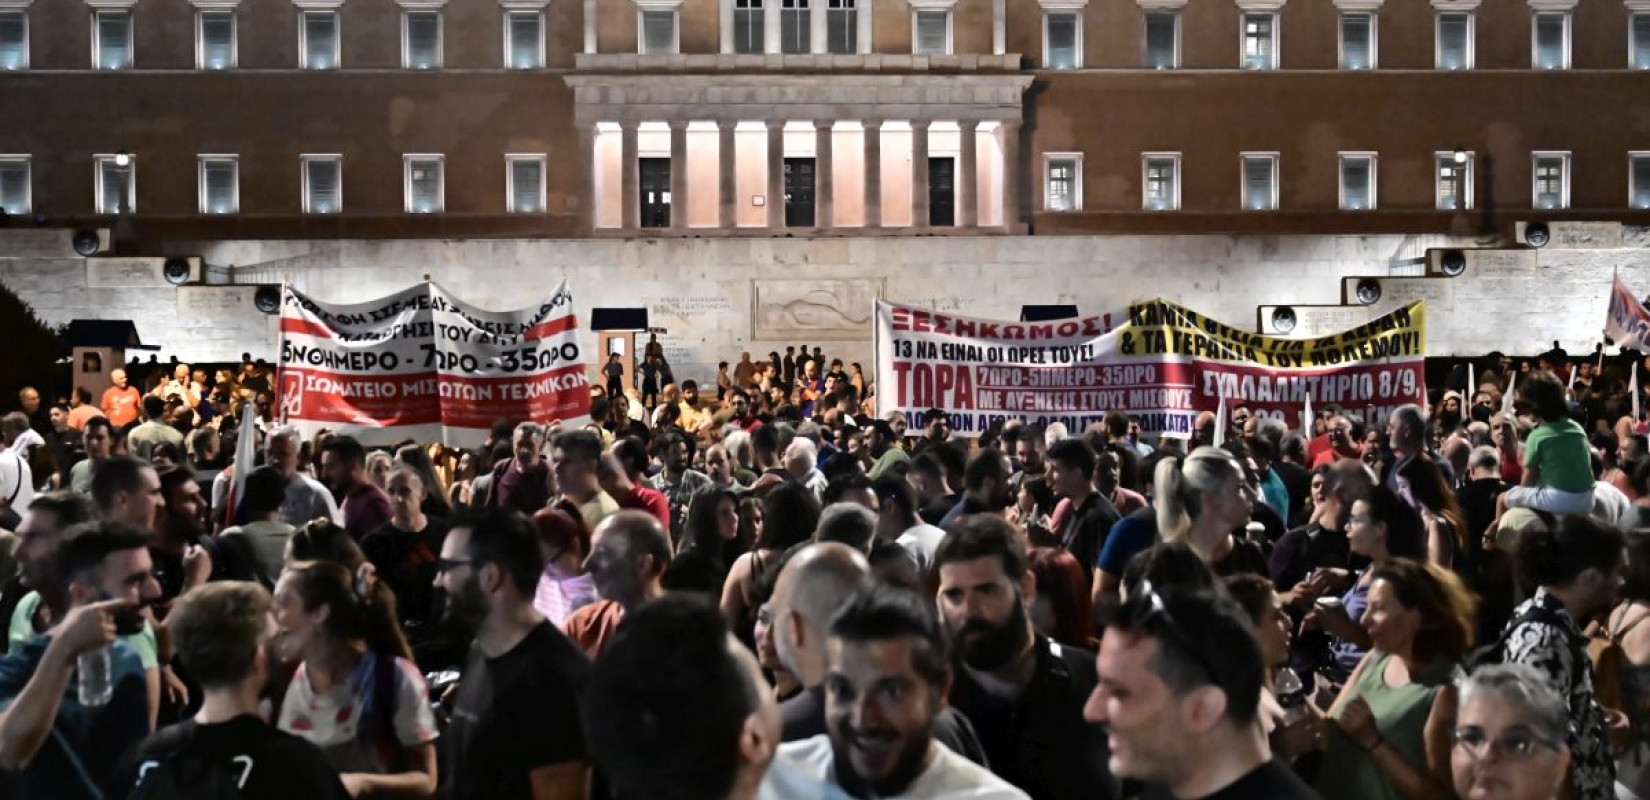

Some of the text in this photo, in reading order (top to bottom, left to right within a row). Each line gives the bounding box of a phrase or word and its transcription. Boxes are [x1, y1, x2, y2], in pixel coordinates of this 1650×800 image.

[891, 307, 1112, 340] ΞΕΣΗΚΩΜΟΣ!
[1129, 303, 1198, 330] ΚΑΜΙΑ
[439, 323, 474, 343] ΤΟΥ
[281, 340, 399, 371] 5ΝΘΗΜΕΡΟ
[419, 343, 478, 373] 7ΩΡΟ
[501, 342, 579, 373] 35ΩΡΟ
[893, 340, 1094, 364] 13 ΝΑ ΕΙΝΑΙ ΟΙ ΩΡΕΣ ΤΟΥΣ!
[1121, 330, 1420, 368] & ΤΑ ΓΕΡΑΚΙΑ ΤΟΥ ΠΟΛΕΜΟΥ!
[305, 371, 589, 401] ΣΩΜΑΤΕΙΟ ΜΙΣΩΤΩΝ ΤΕΧΝΙΚΩΝ
[893, 362, 975, 410] ΤΩΡΑ
[978, 365, 1156, 388] 7ΩΡΟ-5ΗΜΕΡΟ-35ΩΡΟ
[1202, 368, 1420, 403] ΣΥΛΛΑΛΗΤΗΡΙΟ 8/9,
[979, 388, 1193, 411] ΜΕ ΑΥΞΗΣΕΙΣ ΣΤΟΥΣ ΜΙΣΘΟΥΣ
